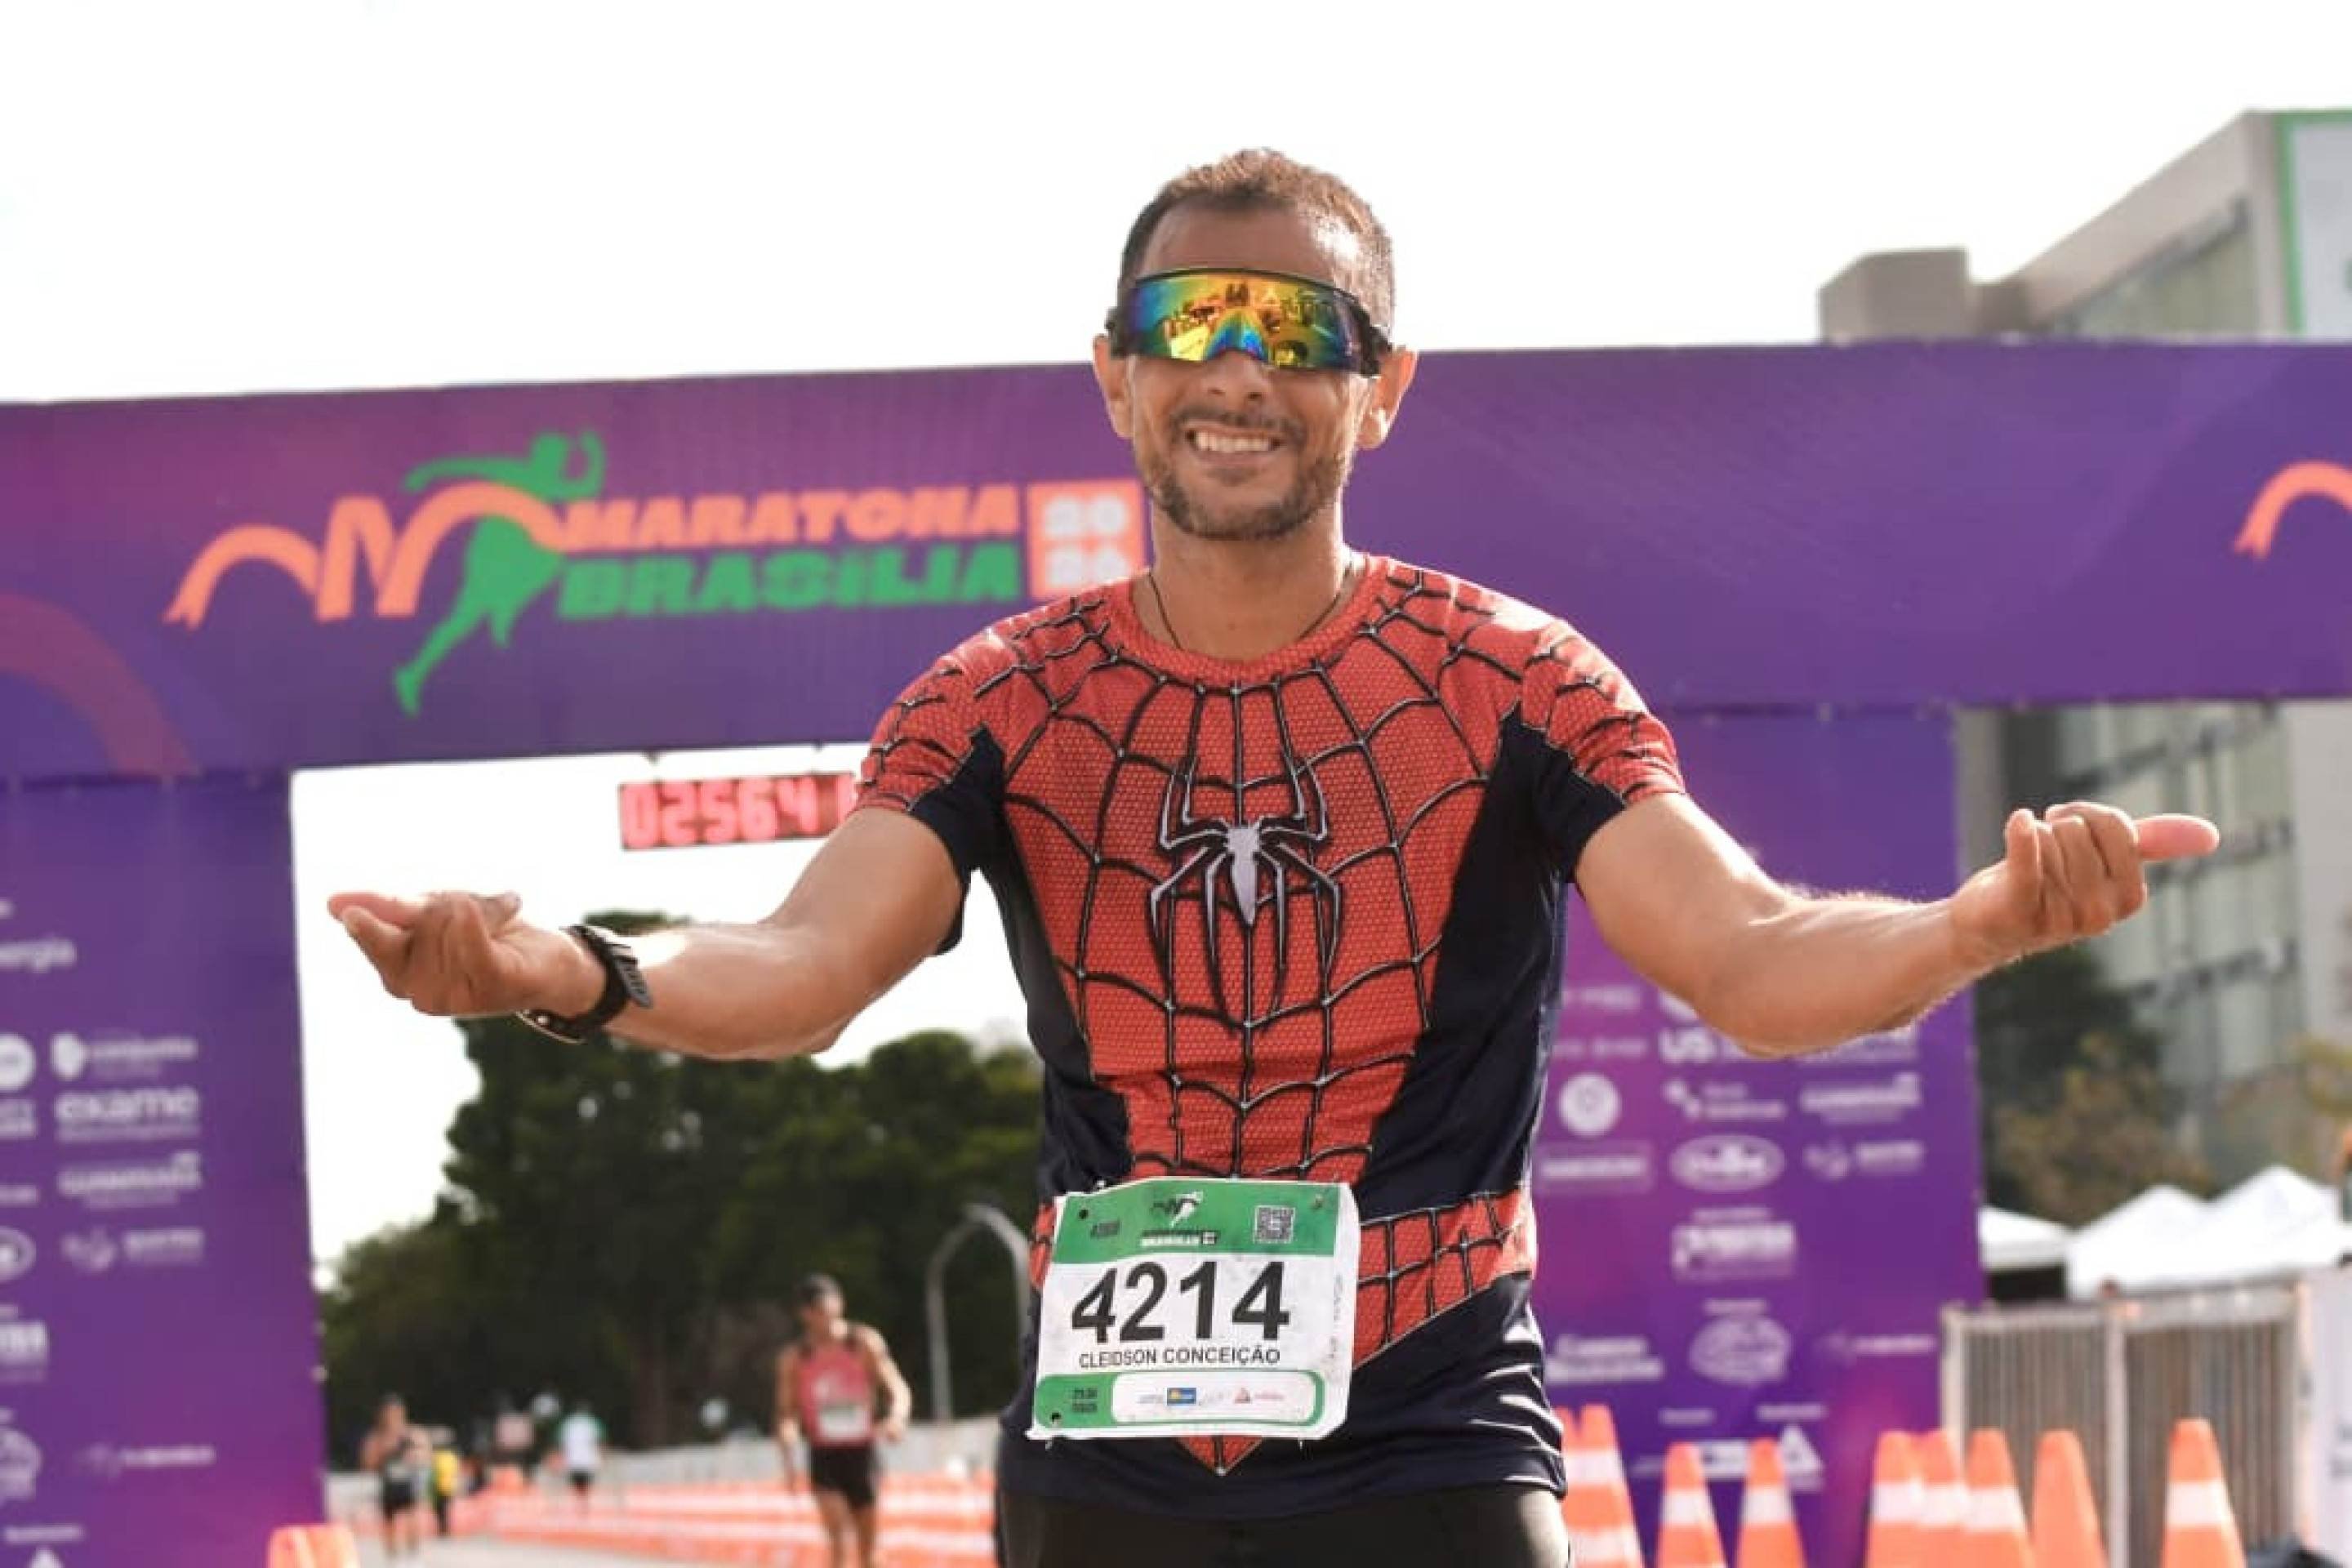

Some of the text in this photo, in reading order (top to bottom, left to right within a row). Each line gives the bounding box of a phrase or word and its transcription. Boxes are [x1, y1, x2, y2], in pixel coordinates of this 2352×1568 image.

[564, 486, 1018, 550] MARATONA
[1071, 1260, 1290, 1343] 4214
[1078, 1344, 1281, 1369] CLEIDSON CONCEIÇÃO
